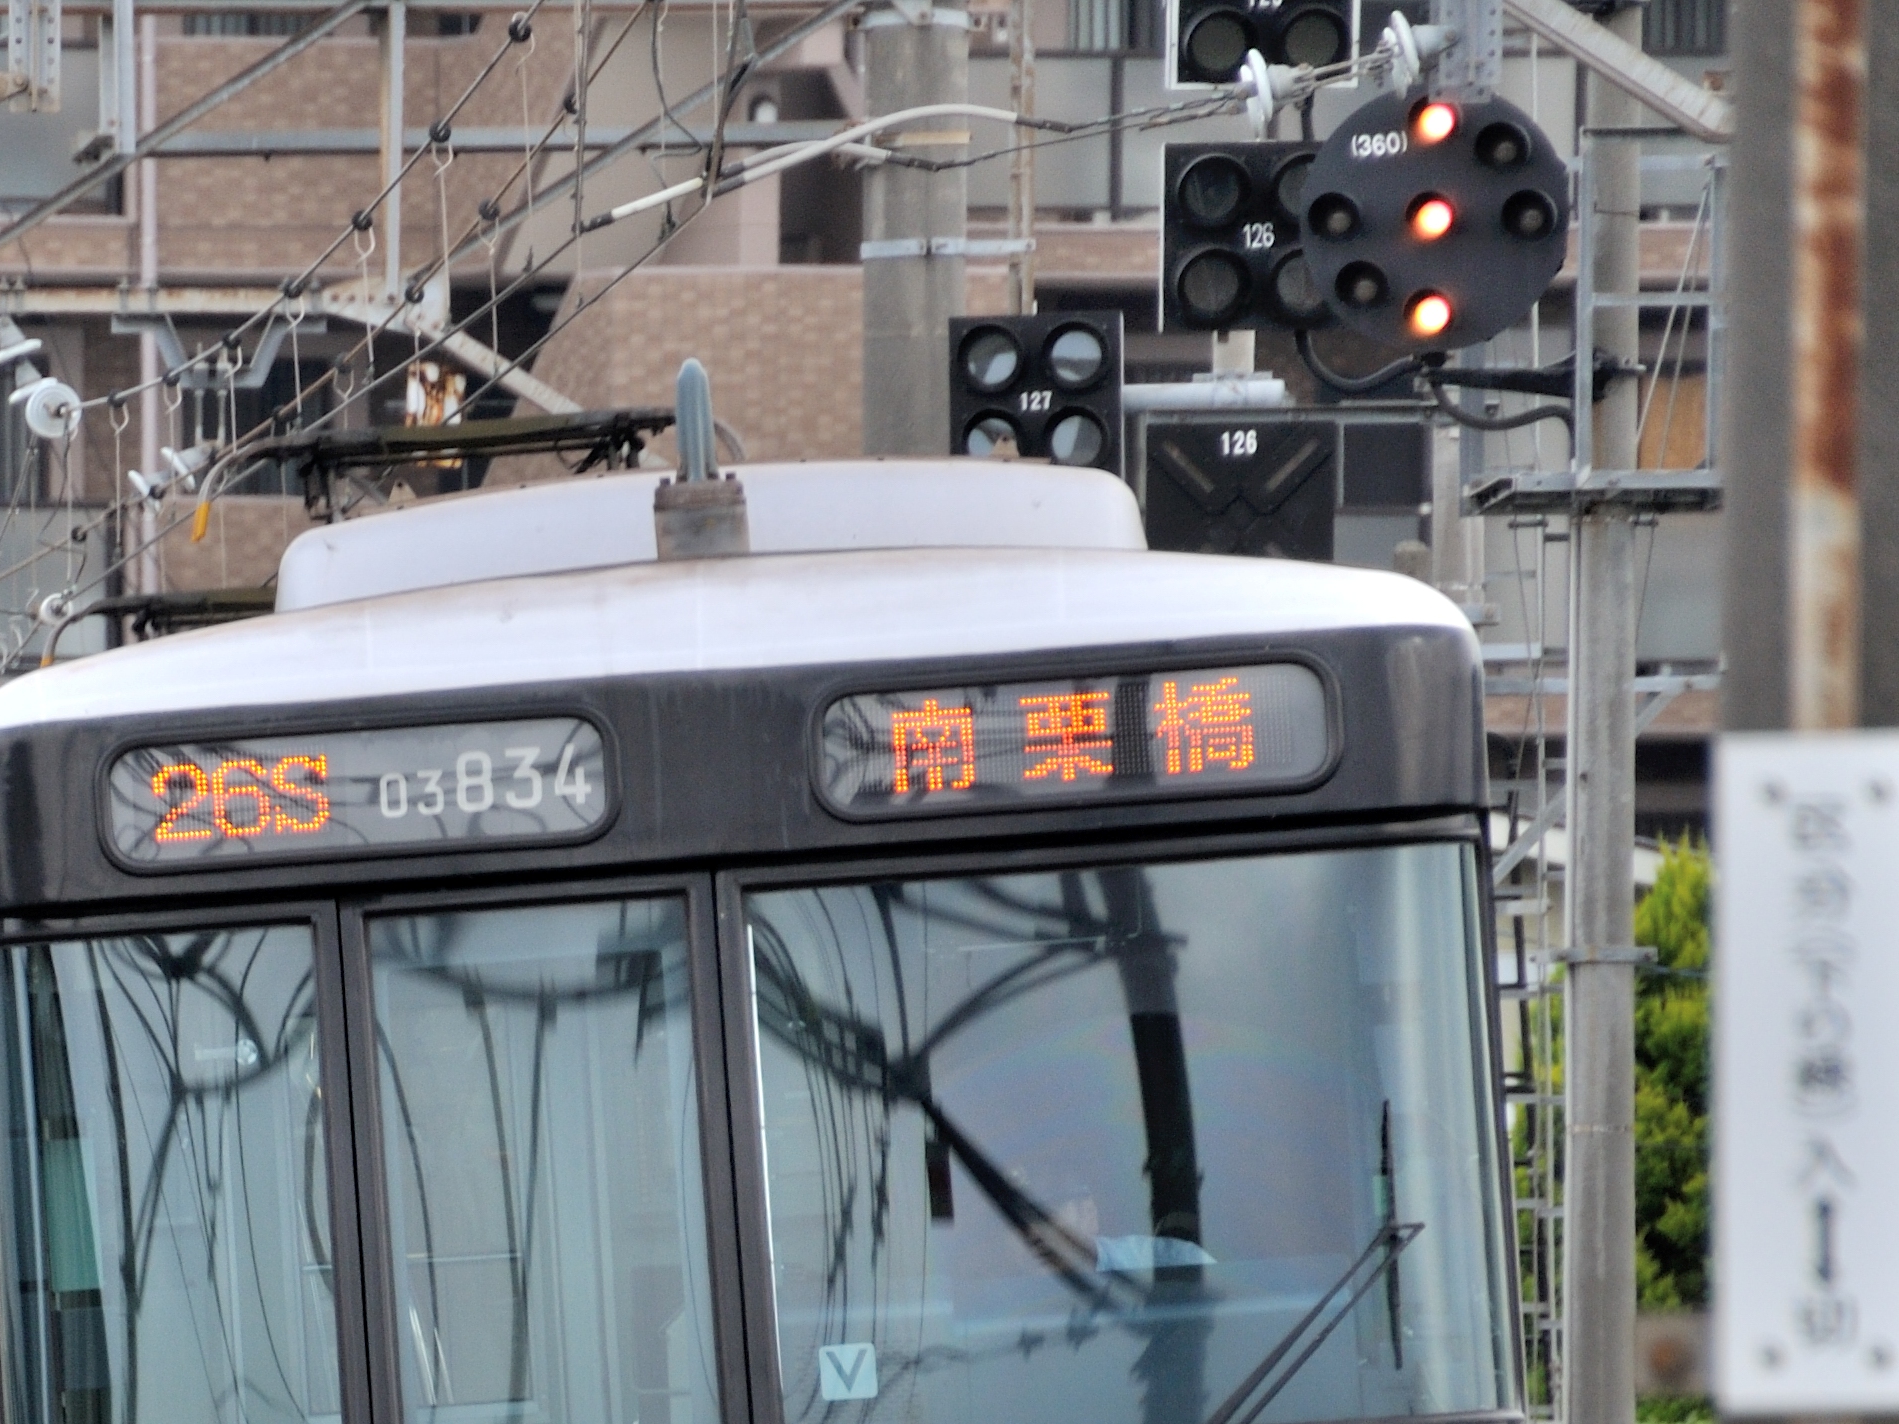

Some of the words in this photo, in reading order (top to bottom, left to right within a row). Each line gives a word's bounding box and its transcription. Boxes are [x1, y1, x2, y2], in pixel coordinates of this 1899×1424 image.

[1351, 131, 1408, 157] (360)
[1242, 222, 1276, 249] 126
[1019, 390, 1053, 412] 127
[1219, 429, 1259, 456] 126
[891, 677, 1255, 793] 南栗橋
[378, 743, 592, 819] 03834
[151, 753, 330, 842] 26S
